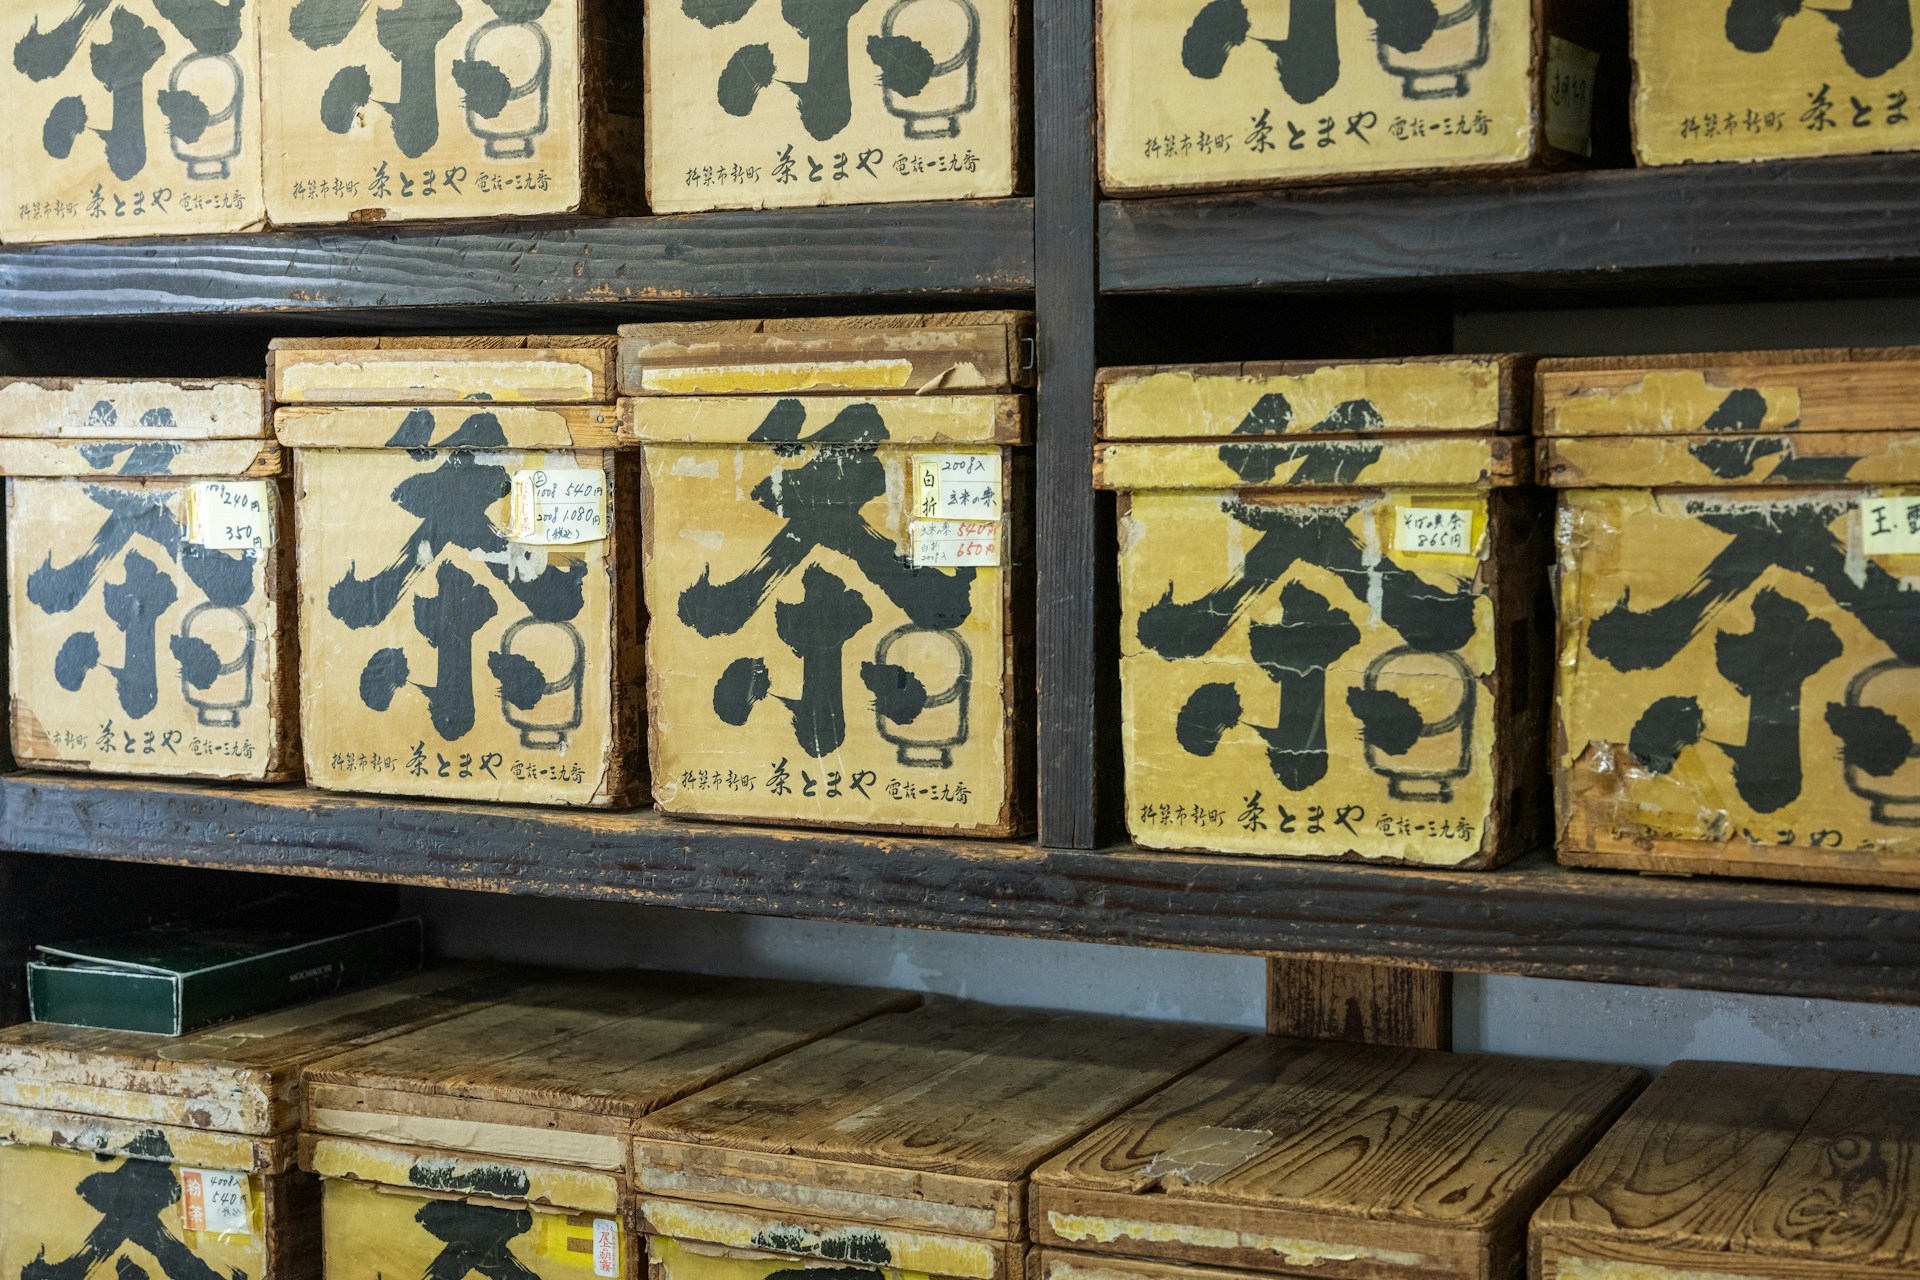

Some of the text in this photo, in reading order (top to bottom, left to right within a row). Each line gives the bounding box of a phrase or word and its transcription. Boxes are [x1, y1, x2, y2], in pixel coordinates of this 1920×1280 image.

[1800, 83, 1908, 131] 茶とま
[1245, 108, 1377, 153] 茶とまや
[1389, 110, 1493, 141] 電話一三九番
[369, 161, 467, 198] 茶とまや
[475, 169, 551, 192] 電話一三九番
[772, 144, 883, 184] 茶とまや
[893, 150, 980, 175] 電話一三九番
[86, 184, 172, 218] 茶とまや
[180, 190, 245, 211] 電話一三九番
[224, 492, 260, 513] 240円
[565, 482, 603, 497] 540円
[922, 469, 938, 517] 白折
[226, 525, 262, 549] 350円
[957, 522, 997, 537] 540円
[1418, 532, 1461, 548] 865円
[957, 541, 995, 558] 650円
[48, 719, 255, 759] 市新町 茶とまや 電話一三九番
[406, 741, 502, 780] 茶とまや
[511, 760, 585, 784] 電話一三九番
[766, 758, 876, 799] 茶とまや
[886, 779, 971, 804] 電話一三九番
[1238, 791, 1365, 836] 茶とまや
[1376, 813, 1475, 842] 電話一三九番
[187, 1178, 204, 1223] 粉茶
[211, 1191, 246, 1206] 540円
